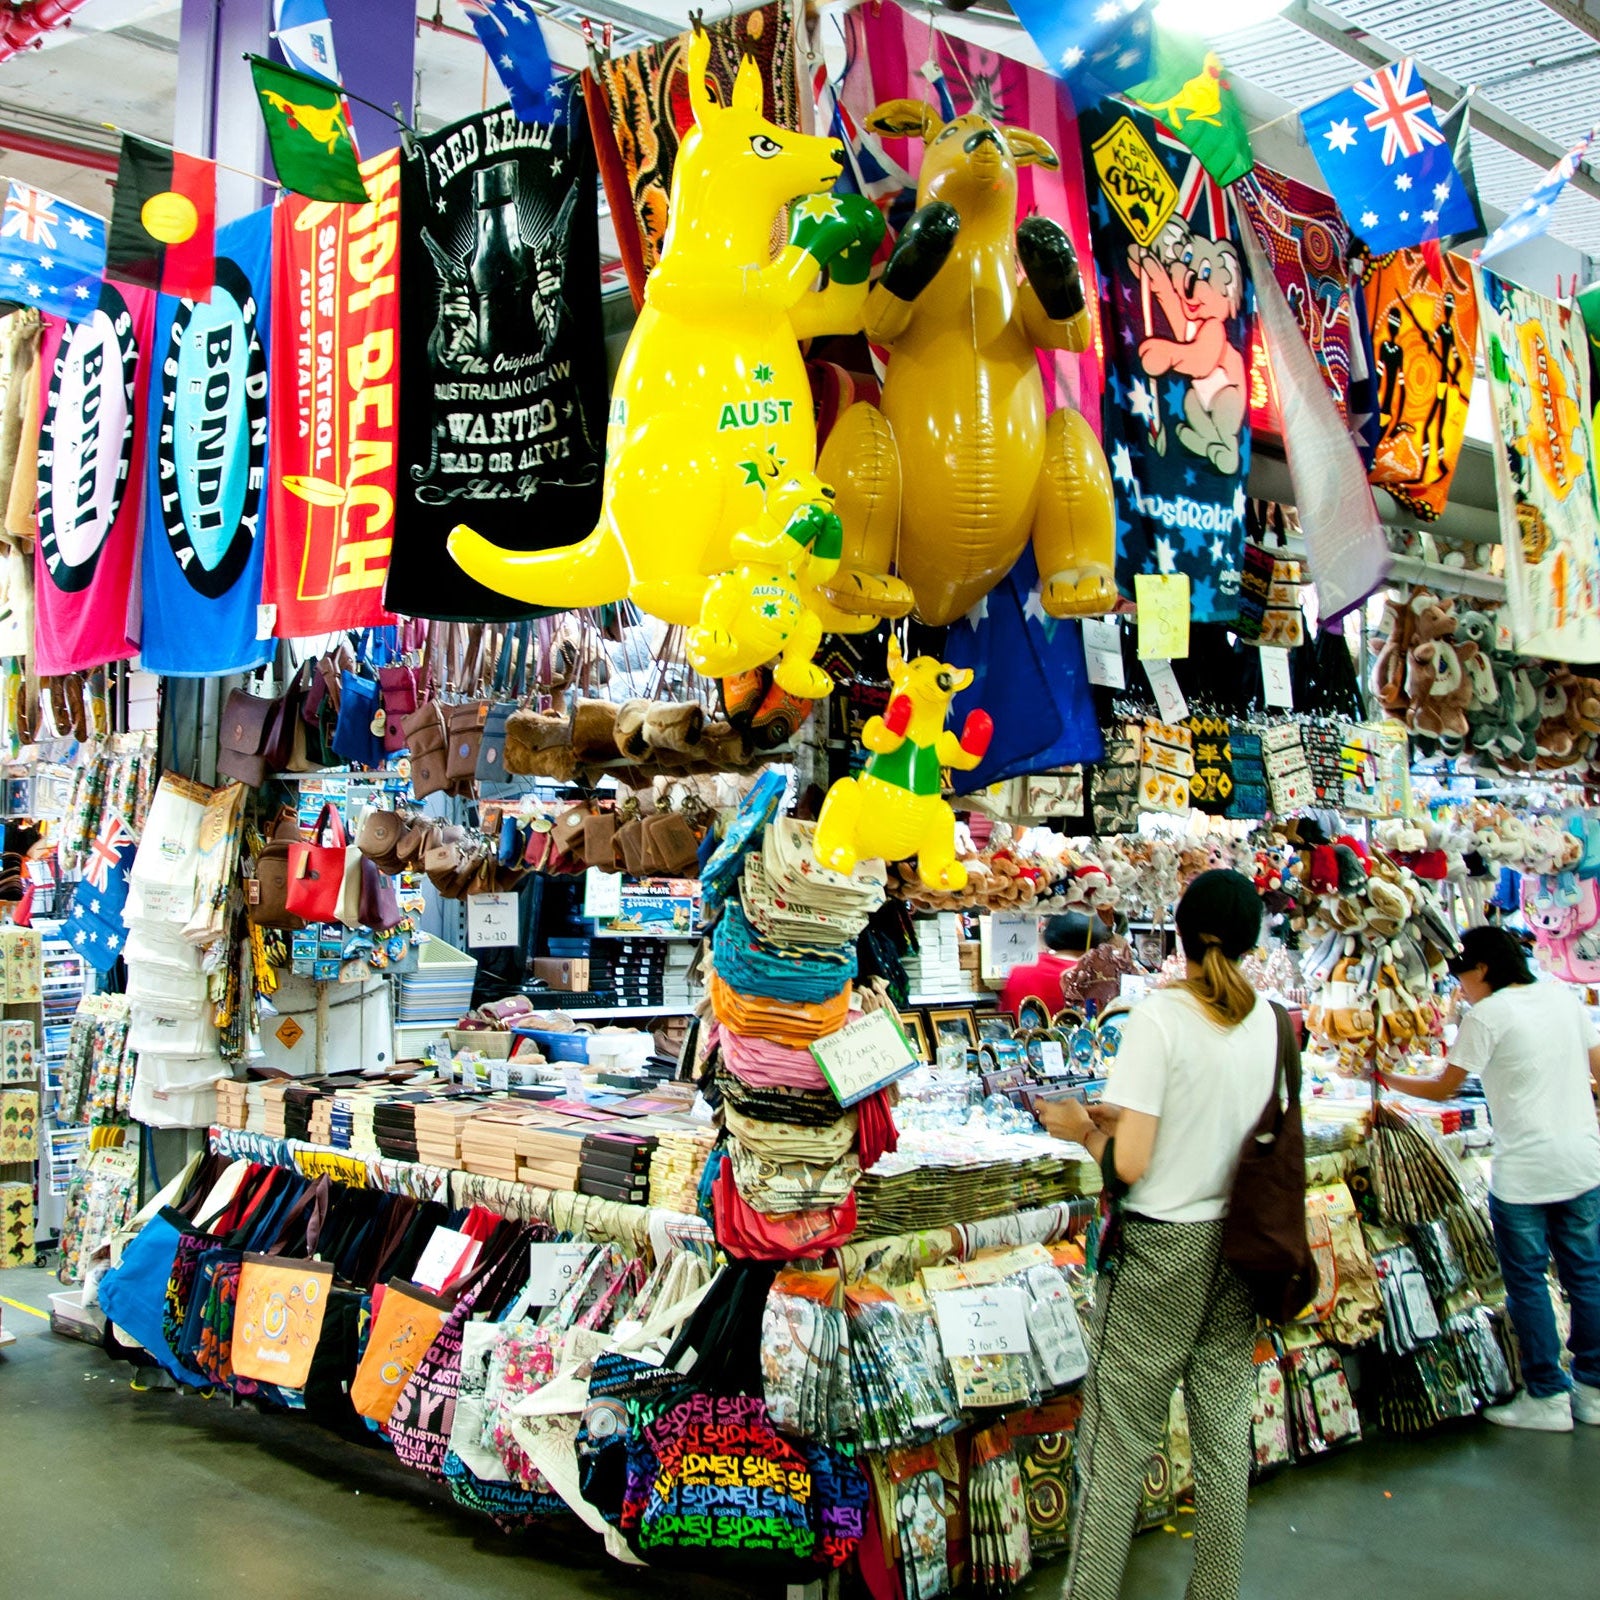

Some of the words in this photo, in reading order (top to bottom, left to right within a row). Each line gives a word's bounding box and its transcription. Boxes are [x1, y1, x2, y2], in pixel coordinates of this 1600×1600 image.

[430, 124, 479, 187] NED
[1112, 147, 1161, 186] KOALA
[317, 224, 336, 318] SURF
[298, 267, 312, 438] AUSTRALIA
[457, 354, 490, 375] The
[493, 344, 548, 376] Original
[315, 329, 333, 471] PATROL
[447, 398, 557, 445] WANTED
[719, 400, 793, 431] AUST
[1535, 331, 1567, 489] AUSTRALIA
[196, 323, 233, 531] BONDI
[332, 329, 395, 597] BEACH
[488, 451, 514, 473] OR
[626, 901, 664, 910] SYDNEY
[787, 903, 812, 915] AUS
[967, 1337, 976, 1351] 3
[979, 1339, 993, 1351] for
[682, 1485, 758, 1509] SYDNEY
